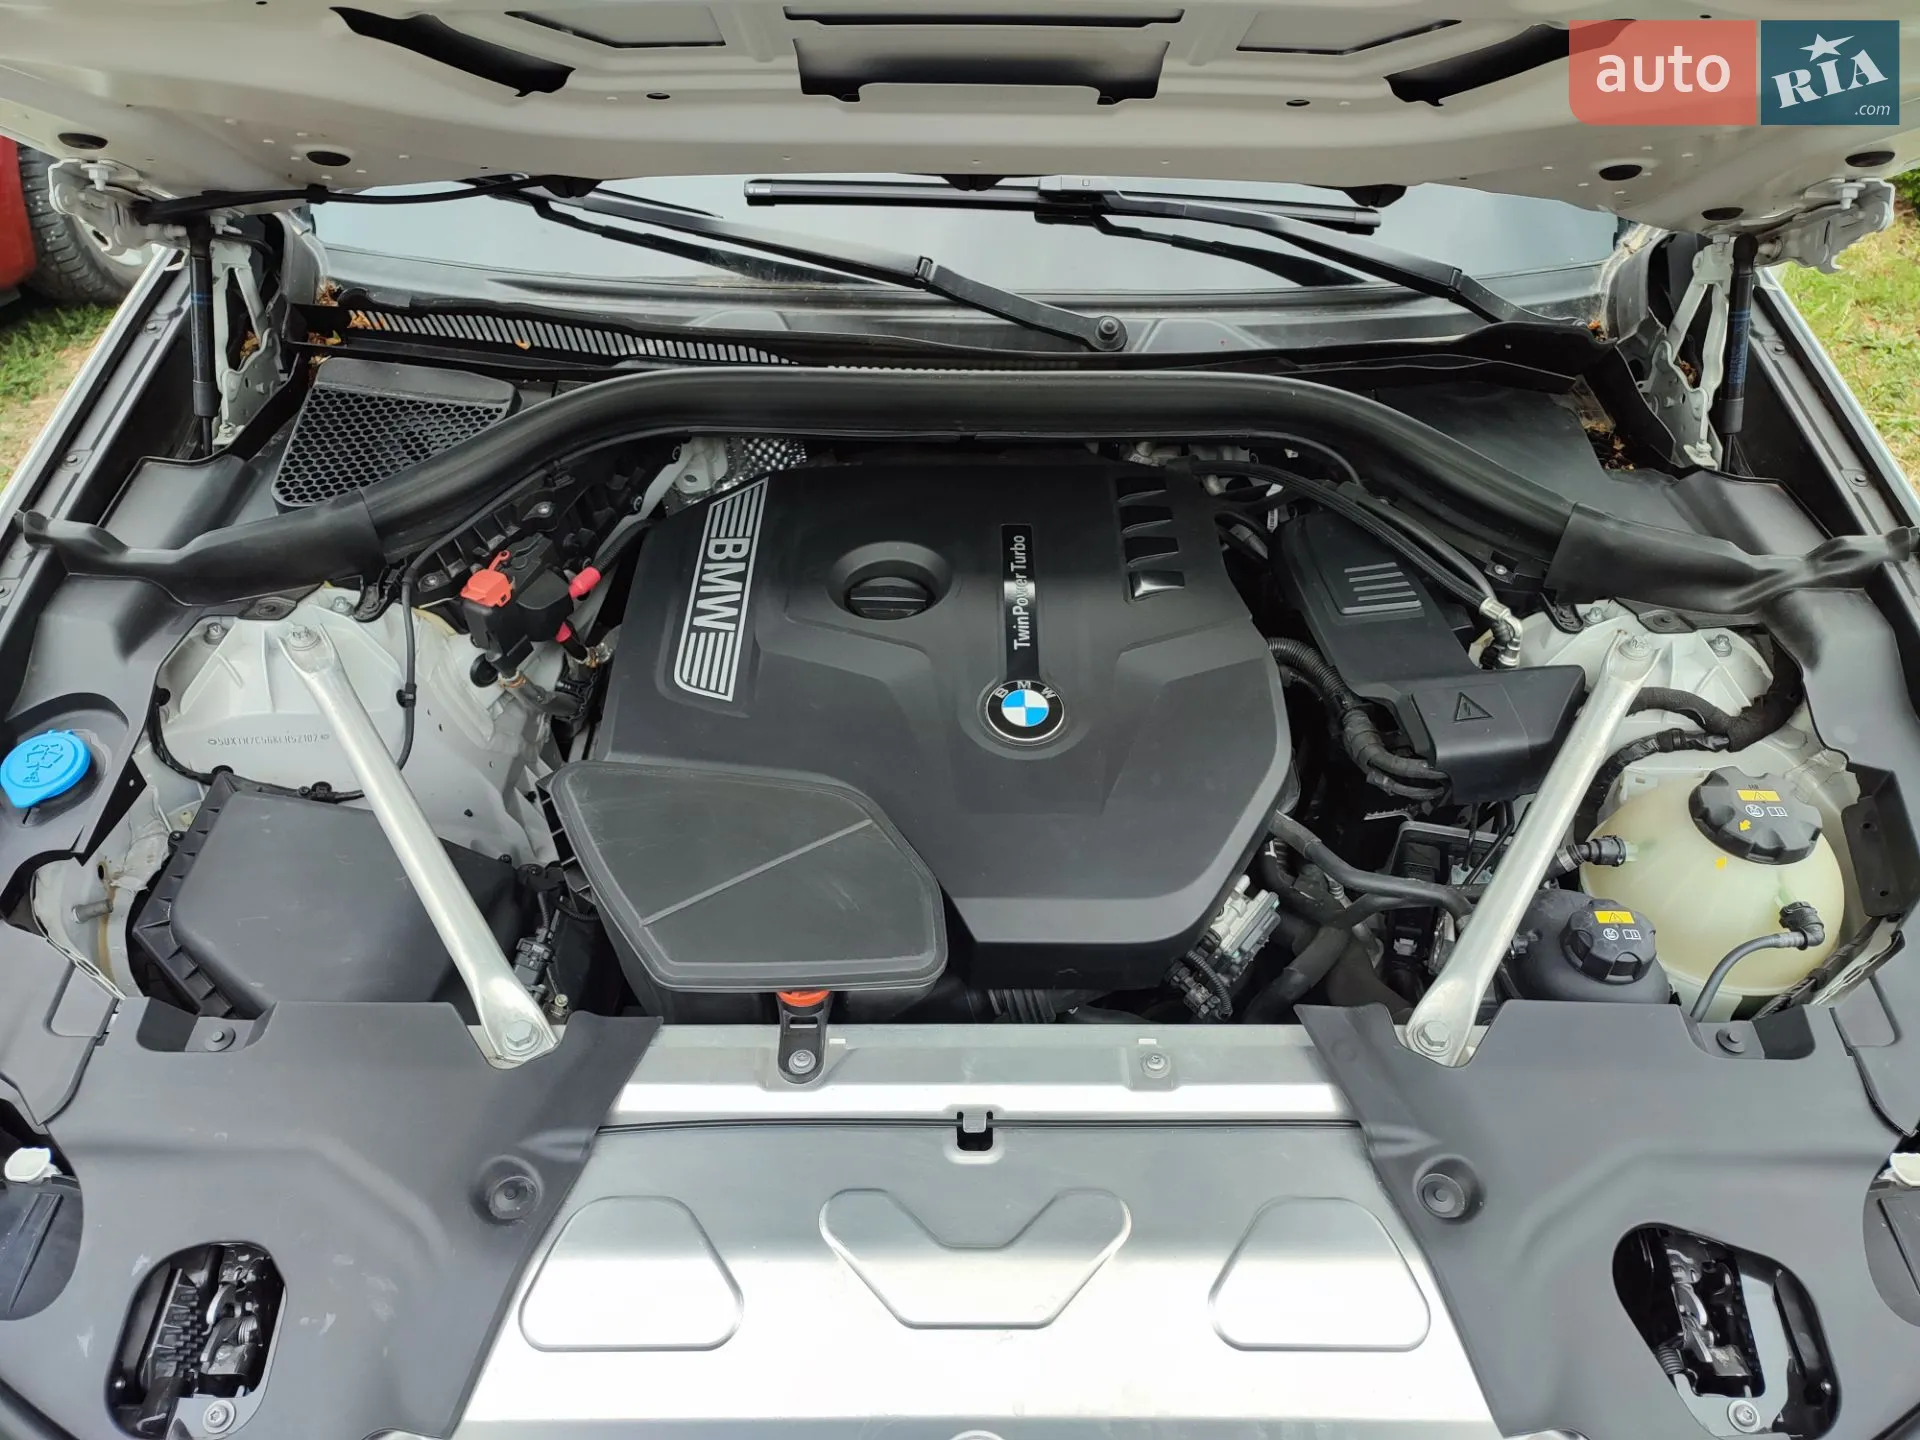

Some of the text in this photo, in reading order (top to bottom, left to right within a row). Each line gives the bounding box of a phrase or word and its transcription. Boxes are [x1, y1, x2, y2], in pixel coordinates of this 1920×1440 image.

[693, 537, 750, 631] BMW
[1010, 535, 1031, 651] TwinPower Turbo
[994, 680, 1058, 699] BMW
